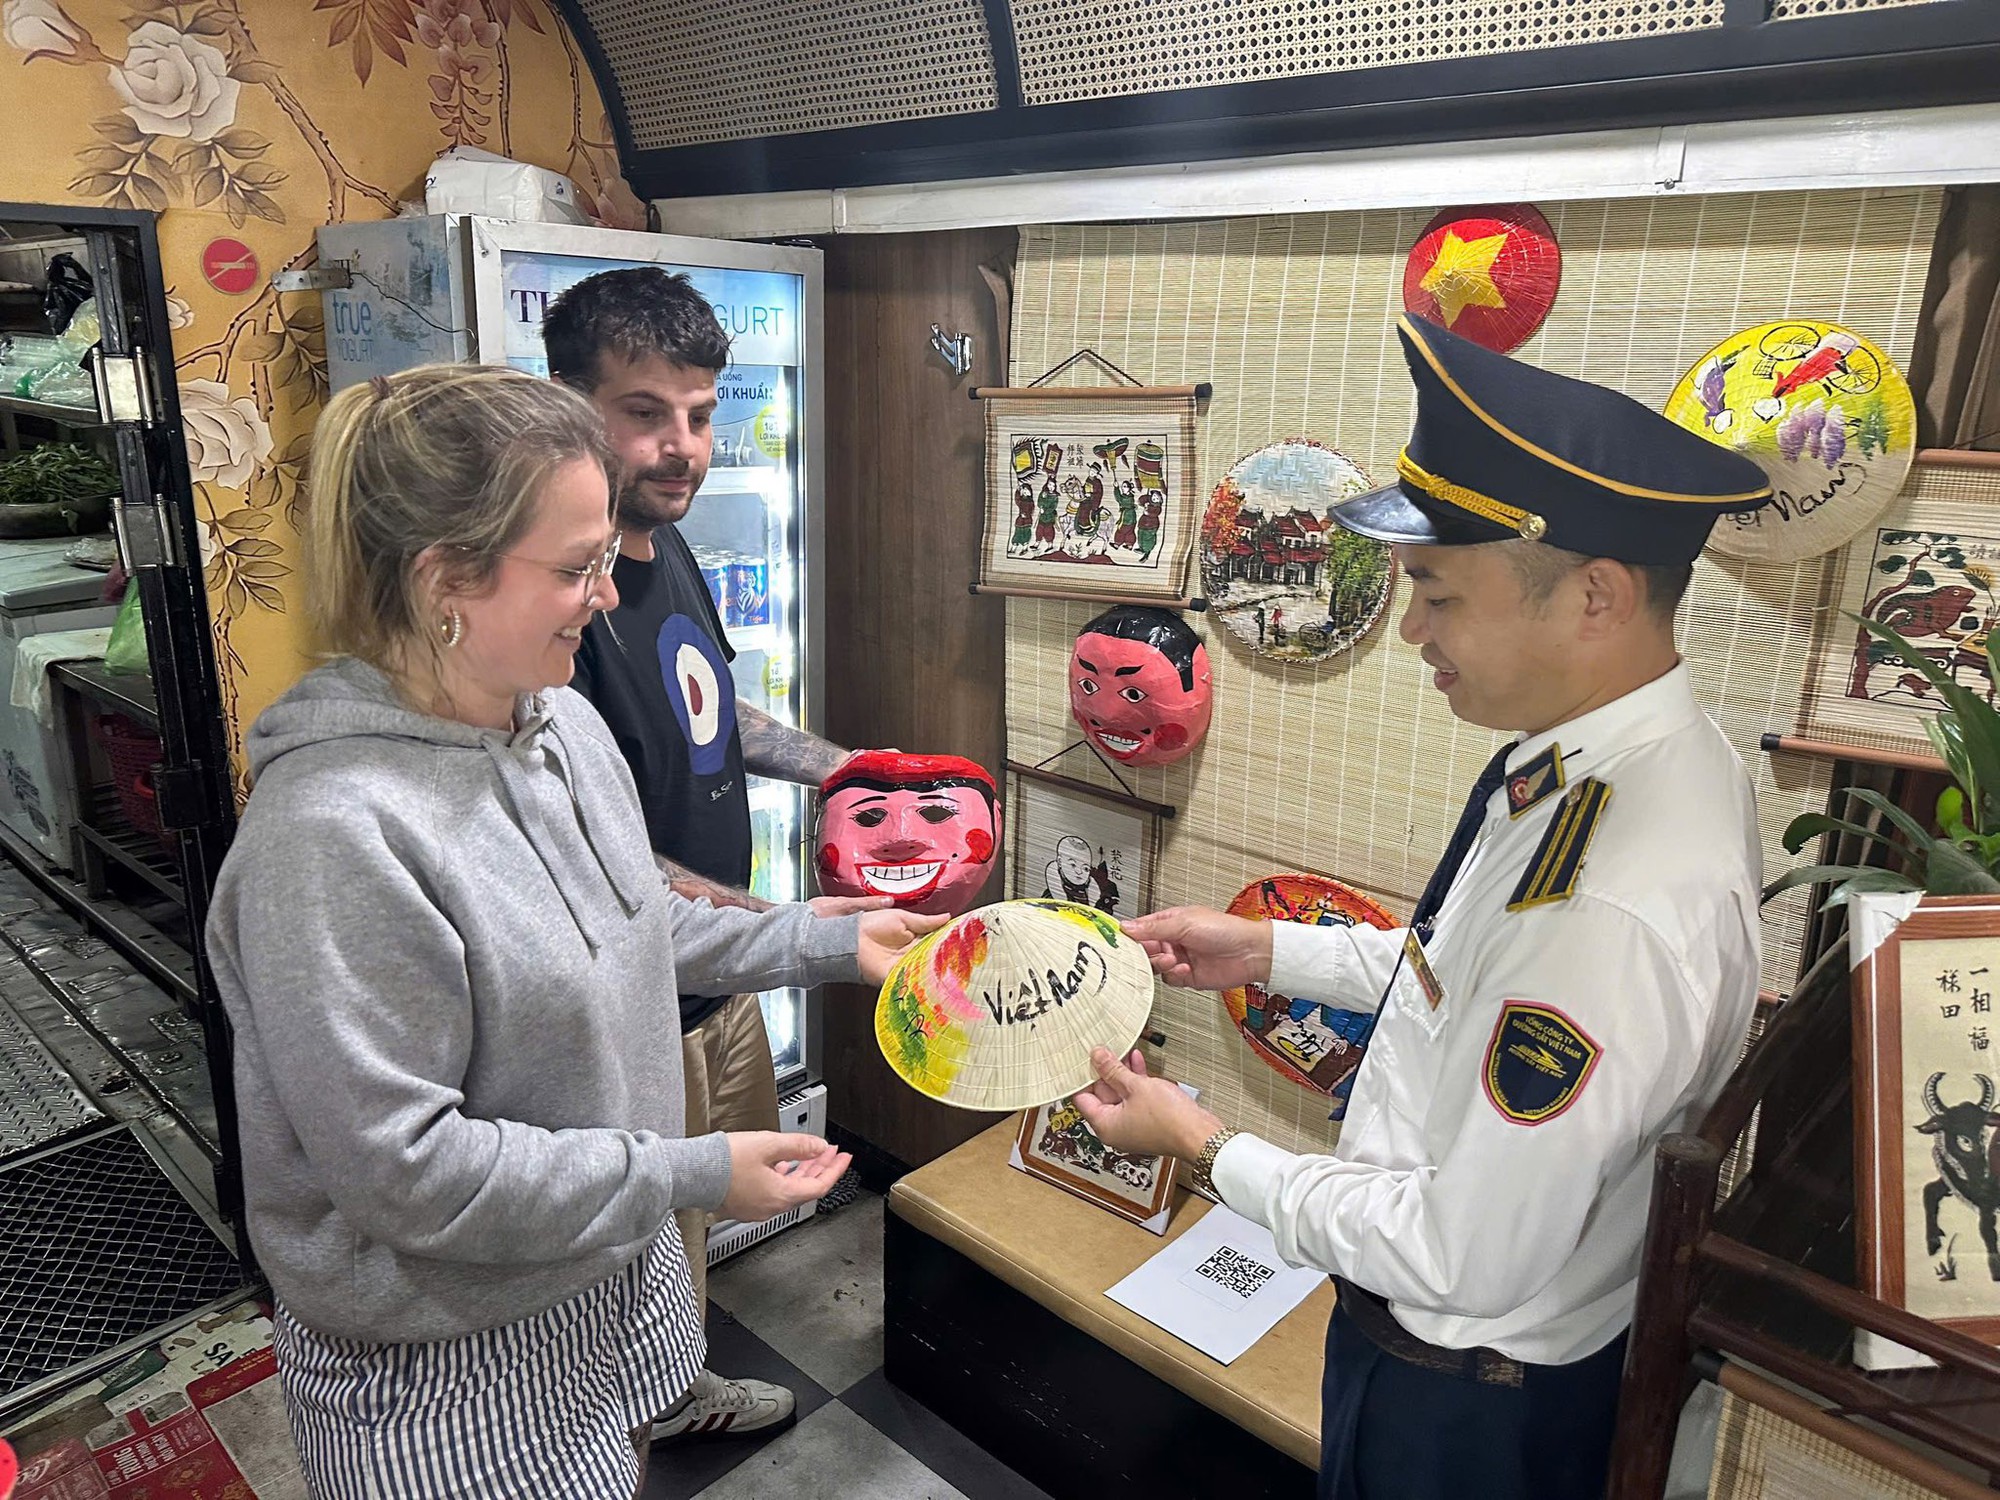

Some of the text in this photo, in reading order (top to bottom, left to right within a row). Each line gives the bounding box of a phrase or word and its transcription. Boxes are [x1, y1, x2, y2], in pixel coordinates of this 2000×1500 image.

[332, 292, 372, 335] true
[713, 304, 784, 335] GURT
[717, 385, 729, 402] ỢI
